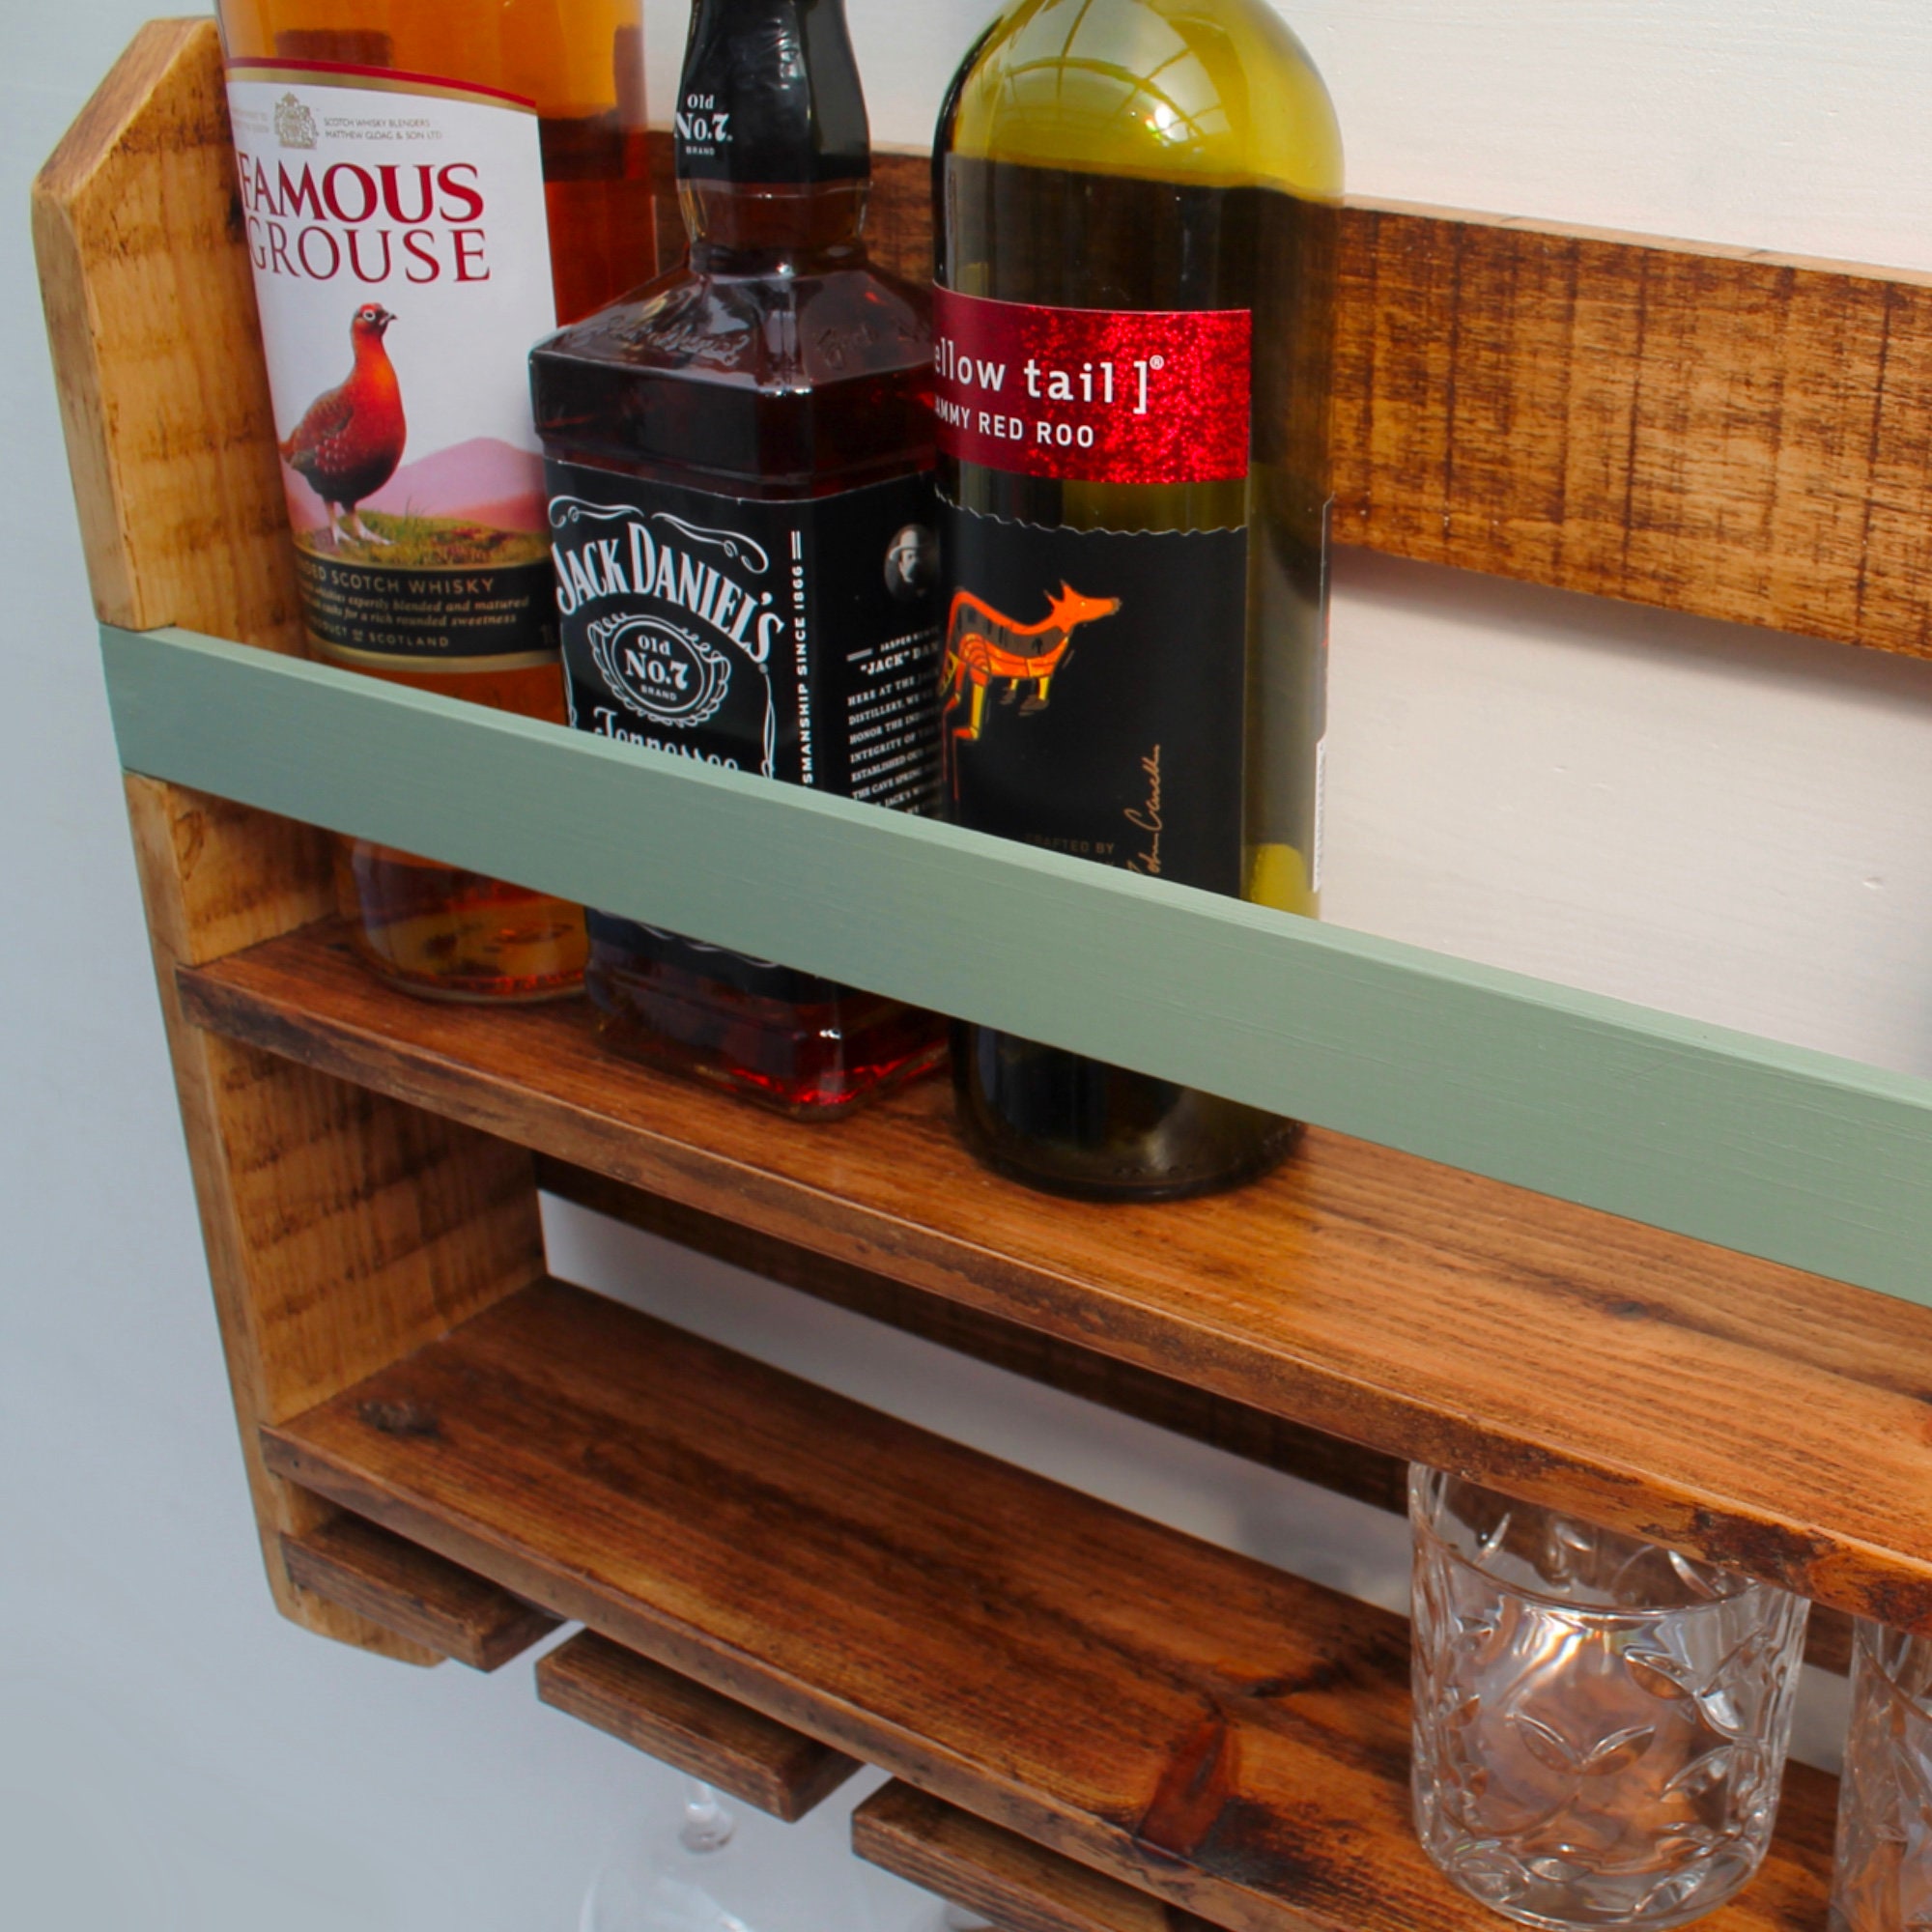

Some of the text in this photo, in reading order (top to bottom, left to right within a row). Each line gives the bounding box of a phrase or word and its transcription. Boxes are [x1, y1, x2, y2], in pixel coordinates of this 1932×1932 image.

[687, 94, 714, 109] Old
[324, 117, 431, 128] SCOTCH WHISKY BLENDERS
[325, 129, 363, 140] MATTHEW
[405, 130, 424, 140] SON
[685, 146, 716, 155] BRAND
[238, 151, 484, 223] FAMOUS
[247, 214, 491, 284] GROUSE
[1024, 358, 1114, 404] tail
[979, 412, 1024, 440] RED
[1037, 421, 1094, 448] ROO
[331, 570, 400, 593] SCOTCH
[408, 577, 494, 595] WHISKY
[551, 522, 784, 664] JACK DANIEL'S
[791, 565, 806, 610] 1866
[444, 598, 470, 612] and
[474, 595, 530, 611] matured
[450, 613, 517, 627] sweetness
[368, 632, 449, 647] SCOTLAND
[638, 634, 670, 656] Old
[793, 616, 809, 676] SINCE
[880, 635, 911, 652] JASPER
[624, 648, 690, 691] No.7
[640, 684, 678, 701] BRAND
[847, 689, 876, 707] HERE
[879, 683, 893, 696] AT
[895, 675, 915, 691] THE
[849, 725, 883, 745] HONOR
[885, 718, 903, 732] THE
[850, 737, 901, 764] INTEGRITY
[1095, 841, 1115, 855] BY
